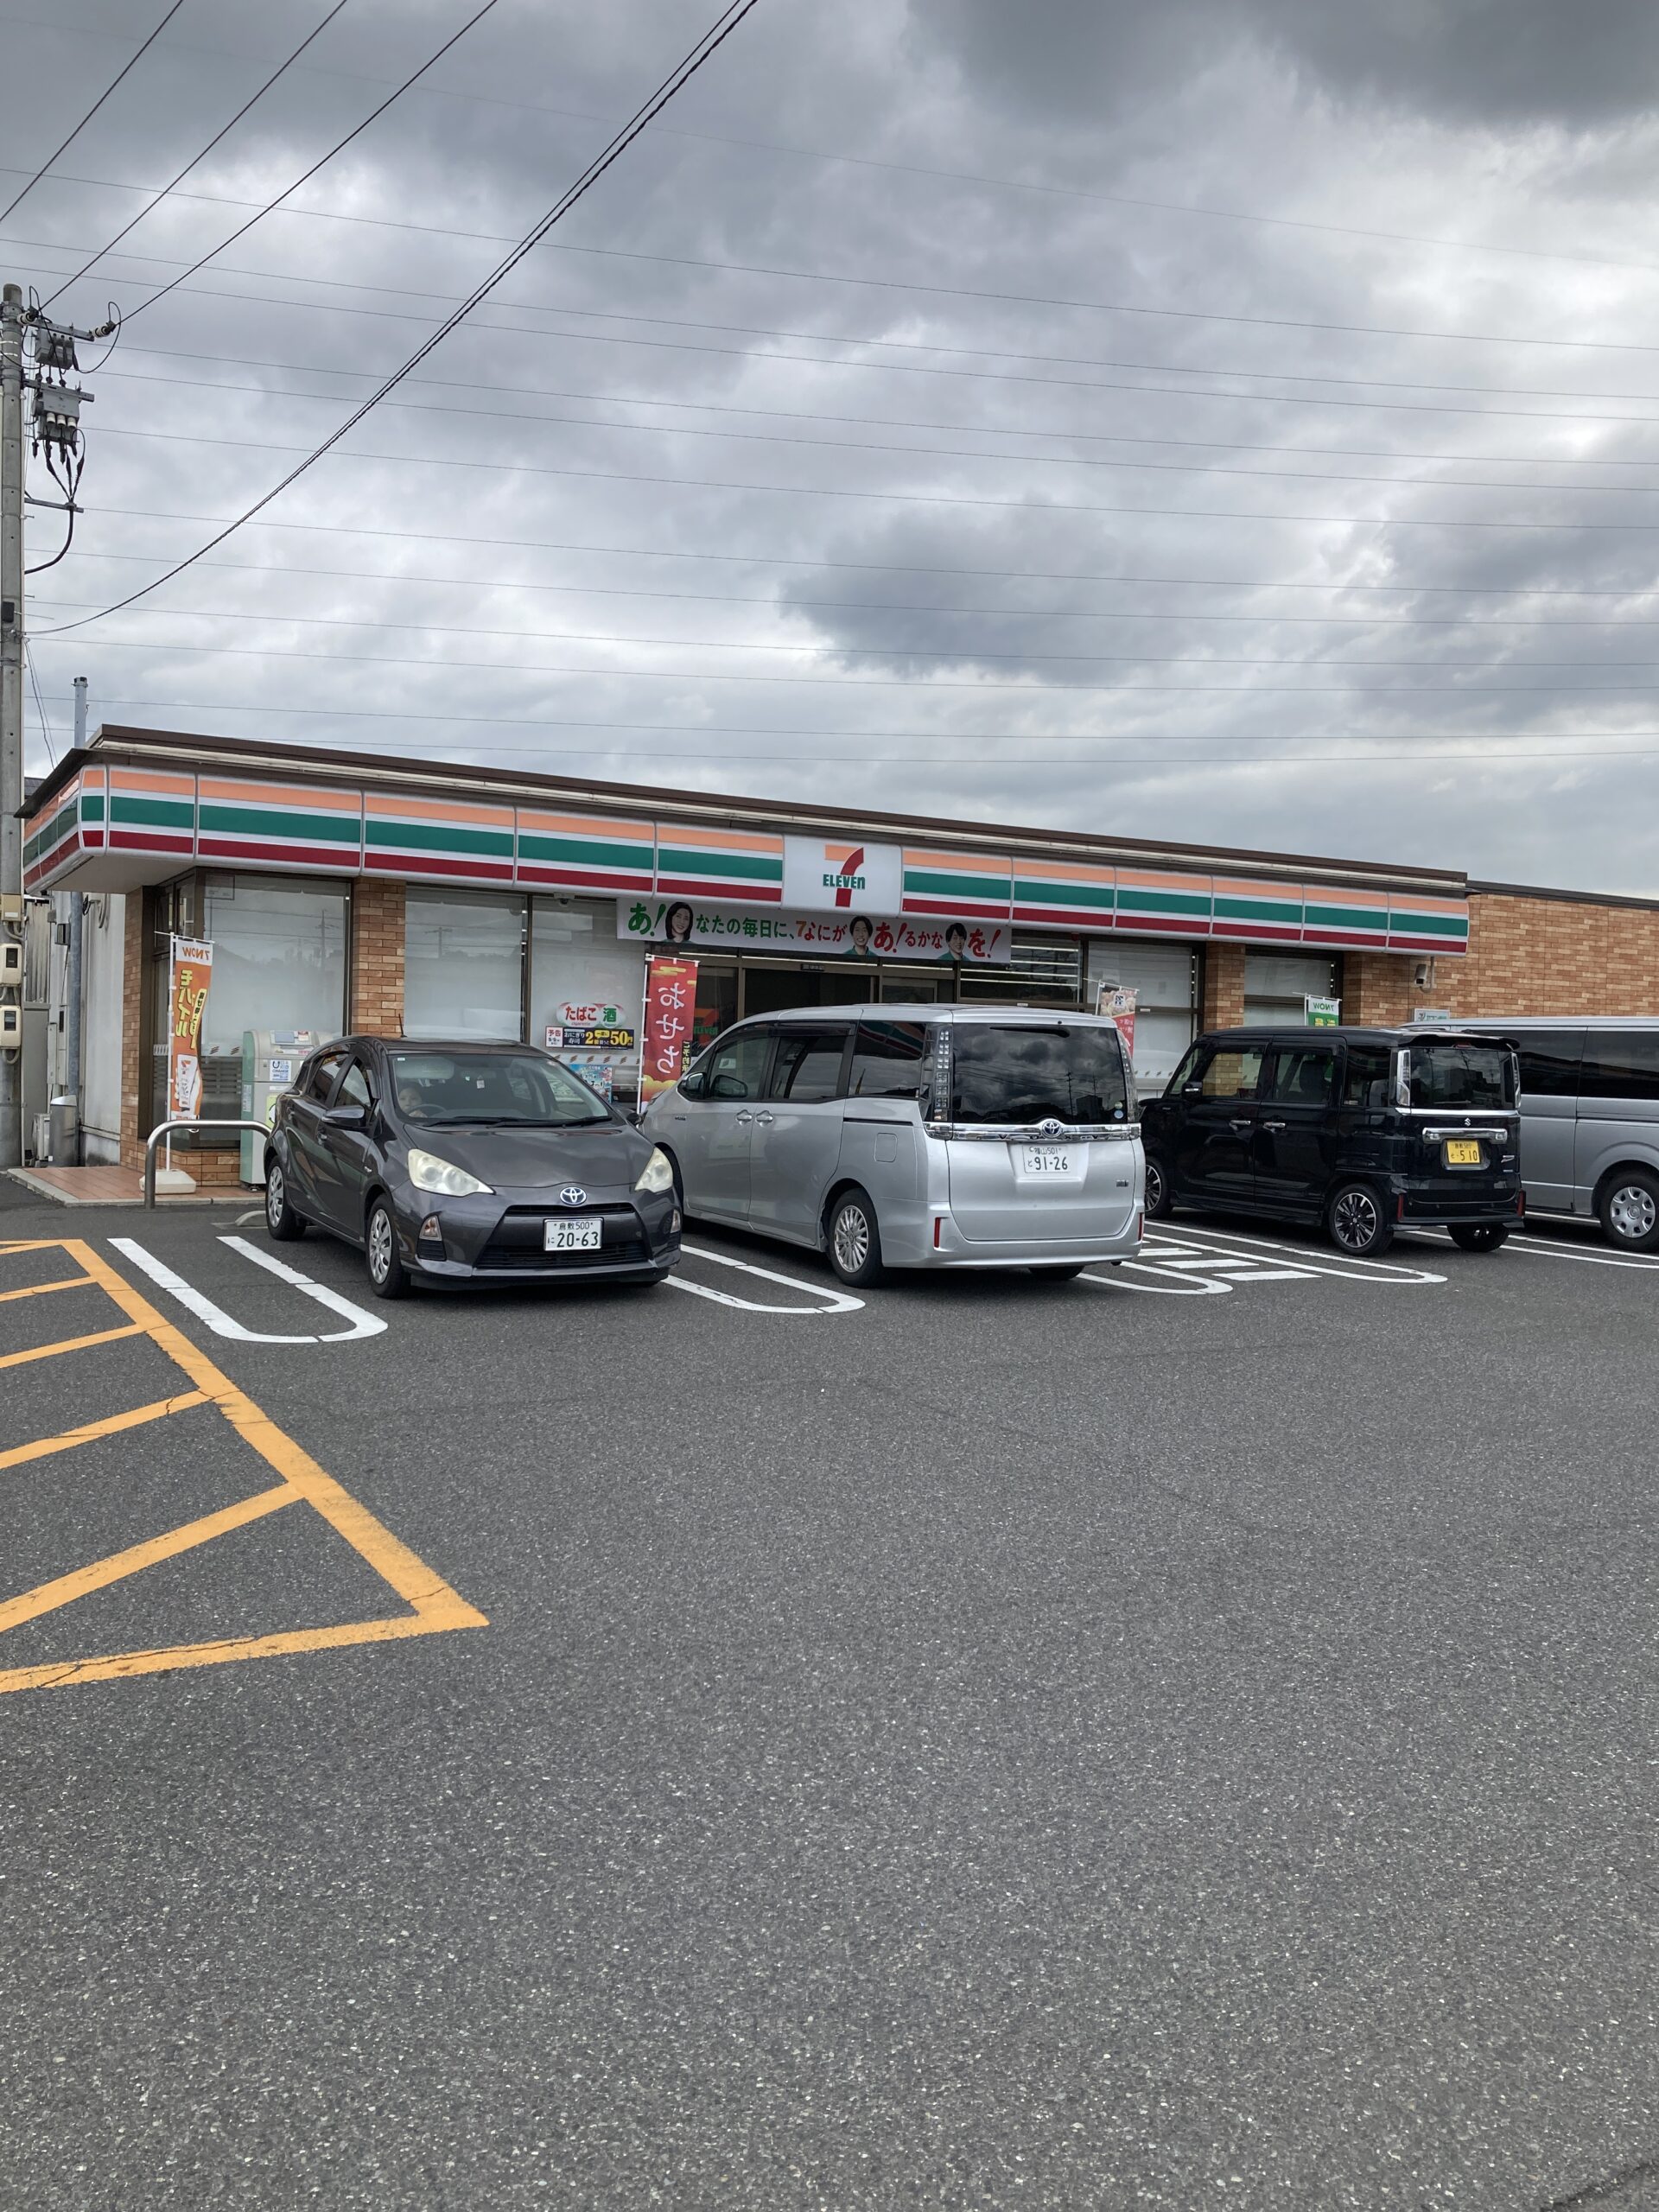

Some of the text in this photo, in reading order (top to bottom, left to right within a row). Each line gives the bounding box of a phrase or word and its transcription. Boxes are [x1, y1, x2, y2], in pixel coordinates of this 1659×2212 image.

[565, 1006, 617, 1022] たばこ 酒
[1034, 1156, 1068, 1171] 91-26
[556, 1231, 599, 1248] 20-63
